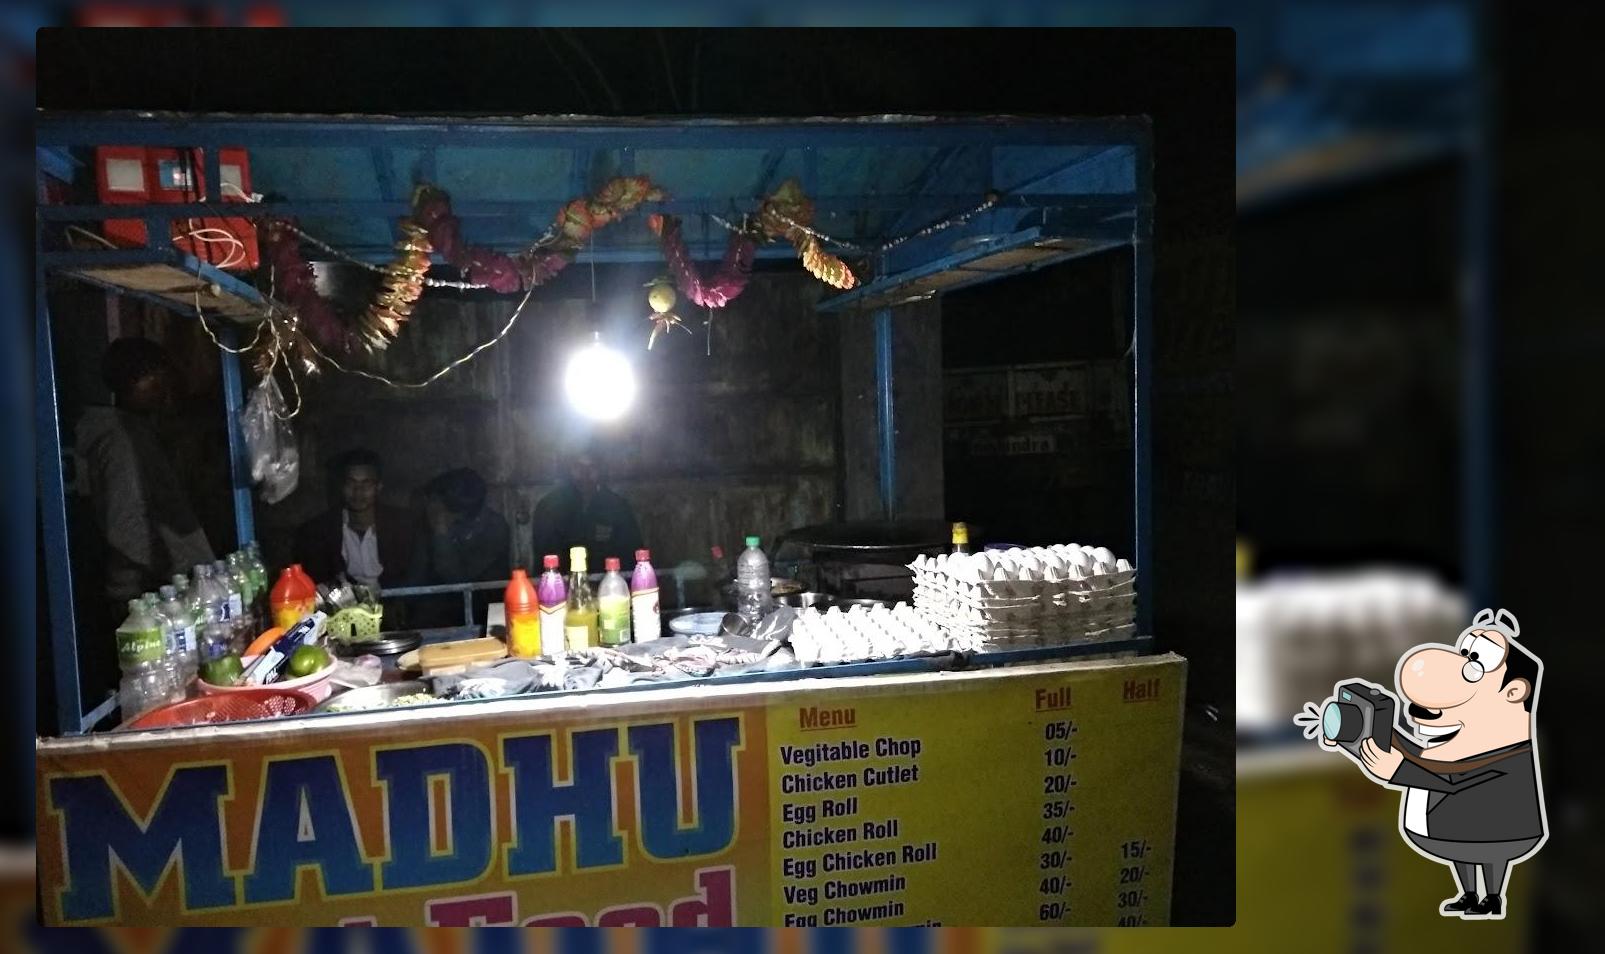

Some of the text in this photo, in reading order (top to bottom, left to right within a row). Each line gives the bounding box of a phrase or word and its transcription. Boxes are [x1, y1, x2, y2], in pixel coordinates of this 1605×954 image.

[1035, 687, 1071, 709] Full
[1123, 679, 1160, 700] Half
[800, 707, 856, 728] Menu
[1045, 721, 1078, 740] 05/-
[781, 738, 921, 767] Vegitable Chop
[1044, 747, 1077, 767] 10/-
[782, 765, 919, 793] Chicken Cutlet
[1044, 775, 1077, 794] 20/-
[47, 713, 745, 921] MADHU
[783, 797, 858, 824] Egg Roll
[1043, 801, 1076, 819] 35/-
[783, 819, 898, 848] Chicken Roll
[1041, 826, 1074, 844] 40/-
[1040, 850, 1073, 869] 30/-
[1121, 840, 1152, 859] 15/-
[783, 842, 937, 879] Egg Chicken Roll
[1120, 865, 1150, 884] 20/-
[784, 874, 906, 905] Veg Chowmin
[1040, 875, 1072, 895] 40/-
[1117, 889, 1148, 908] 30/-
[823, 901, 904, 925] Chowmin
[1040, 902, 1072, 921] 60/-
